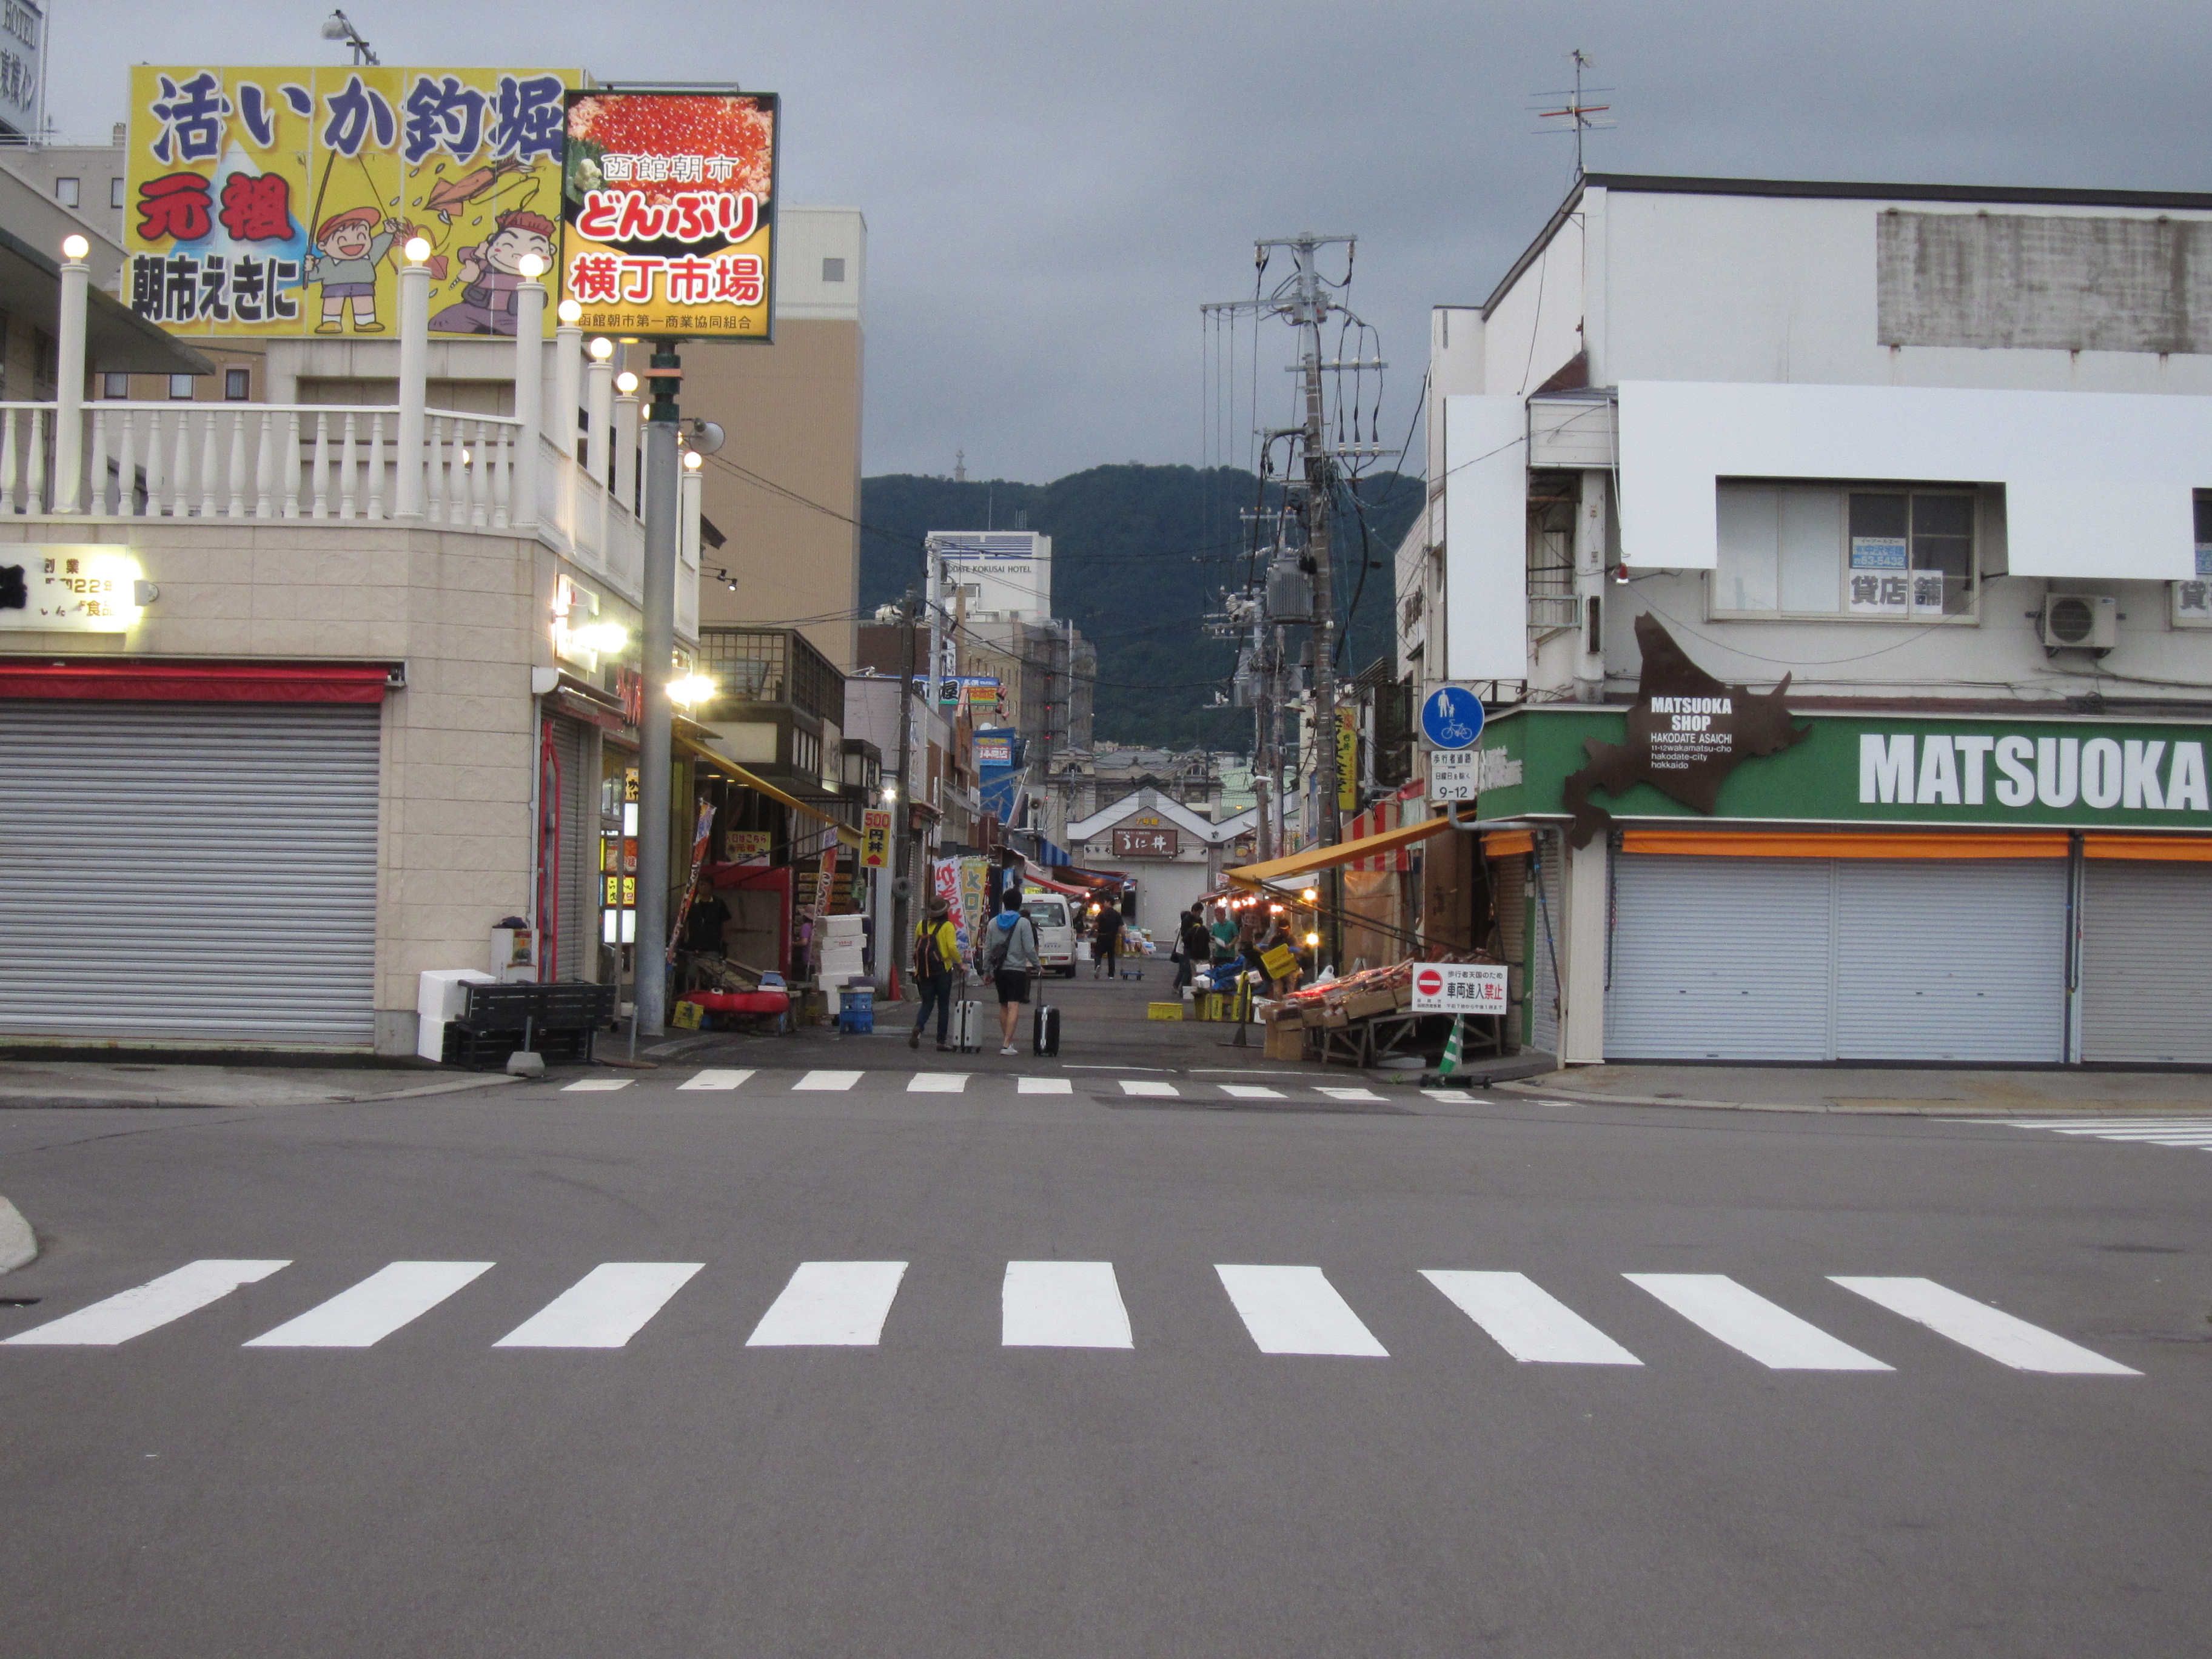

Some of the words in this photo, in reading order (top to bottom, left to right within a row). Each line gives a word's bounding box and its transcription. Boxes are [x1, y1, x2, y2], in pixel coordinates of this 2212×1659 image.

[4, 0, 35, 50] HOTEL
[150, 71, 564, 167] 活いか釣堀
[602, 153, 740, 183] 函館朝市
[136, 172, 295, 241] 元祖
[578, 191, 759, 244] どんぶり
[568, 252, 764, 305] 横丁市場
[132, 253, 298, 323] 朝市えきに
[578, 314, 752, 330] 函館朝市第一商業協同組合
[1851, 576, 1941, 605] 貸店舗
[1651, 697, 1732, 714] MATSUOKA
[1672, 715, 1711, 731] SHOP
[1651, 733, 1696, 743] HAKODATE
[1698, 734, 1732, 744] ASAICHI
[1434, 753, 1472, 764] 歩行者道路
[1652, 753, 1708, 762] hakodate-city
[1435, 772, 1471, 780] 日曜日を除く
[1859, 734, 2210, 811] MATSUOKA
[1439, 786, 1467, 798] 9-12
[865, 813, 890, 828] 500
[868, 828, 883, 853] 円丼
[1123, 834, 1167, 851] うに丼
[965, 870, 982, 932] メロン
[1447, 971, 1503, 979] 歩行者天国のため
[1447, 982, 1503, 1000] 車両進入禁止
